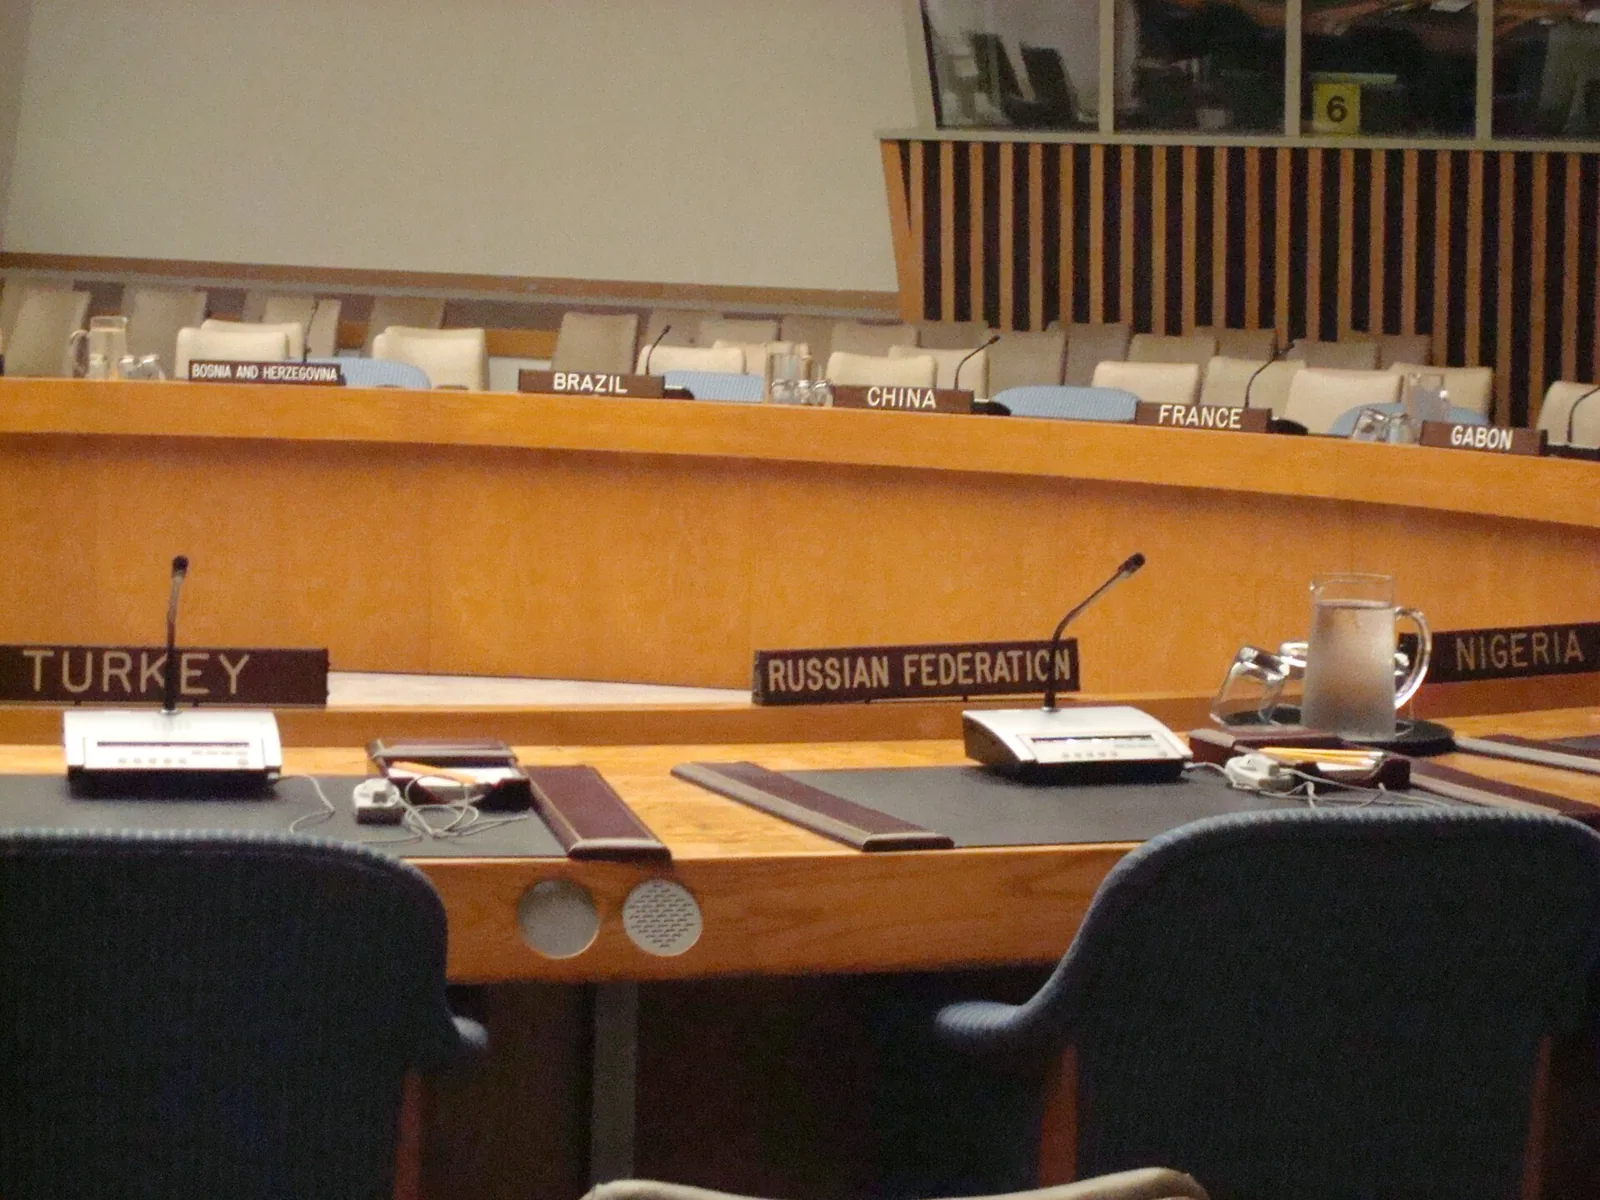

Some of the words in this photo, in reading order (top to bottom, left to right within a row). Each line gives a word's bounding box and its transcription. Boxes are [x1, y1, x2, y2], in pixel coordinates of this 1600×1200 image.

[1326, 95, 1347, 122] 6
[191, 363, 232, 378] BOSNIA
[235, 364, 259, 379] AND
[262, 365, 338, 382] HERZEGOVINA
[552, 372, 628, 395] BRAZIL
[866, 387, 937, 410] CHINA
[1158, 404, 1242, 429] FRANCE
[1450, 425, 1514, 450] GABON
[1455, 630, 1585, 671] NIGERIA
[22, 650, 251, 695] TURKEY
[768, 656, 889, 692] RUSSIAN
